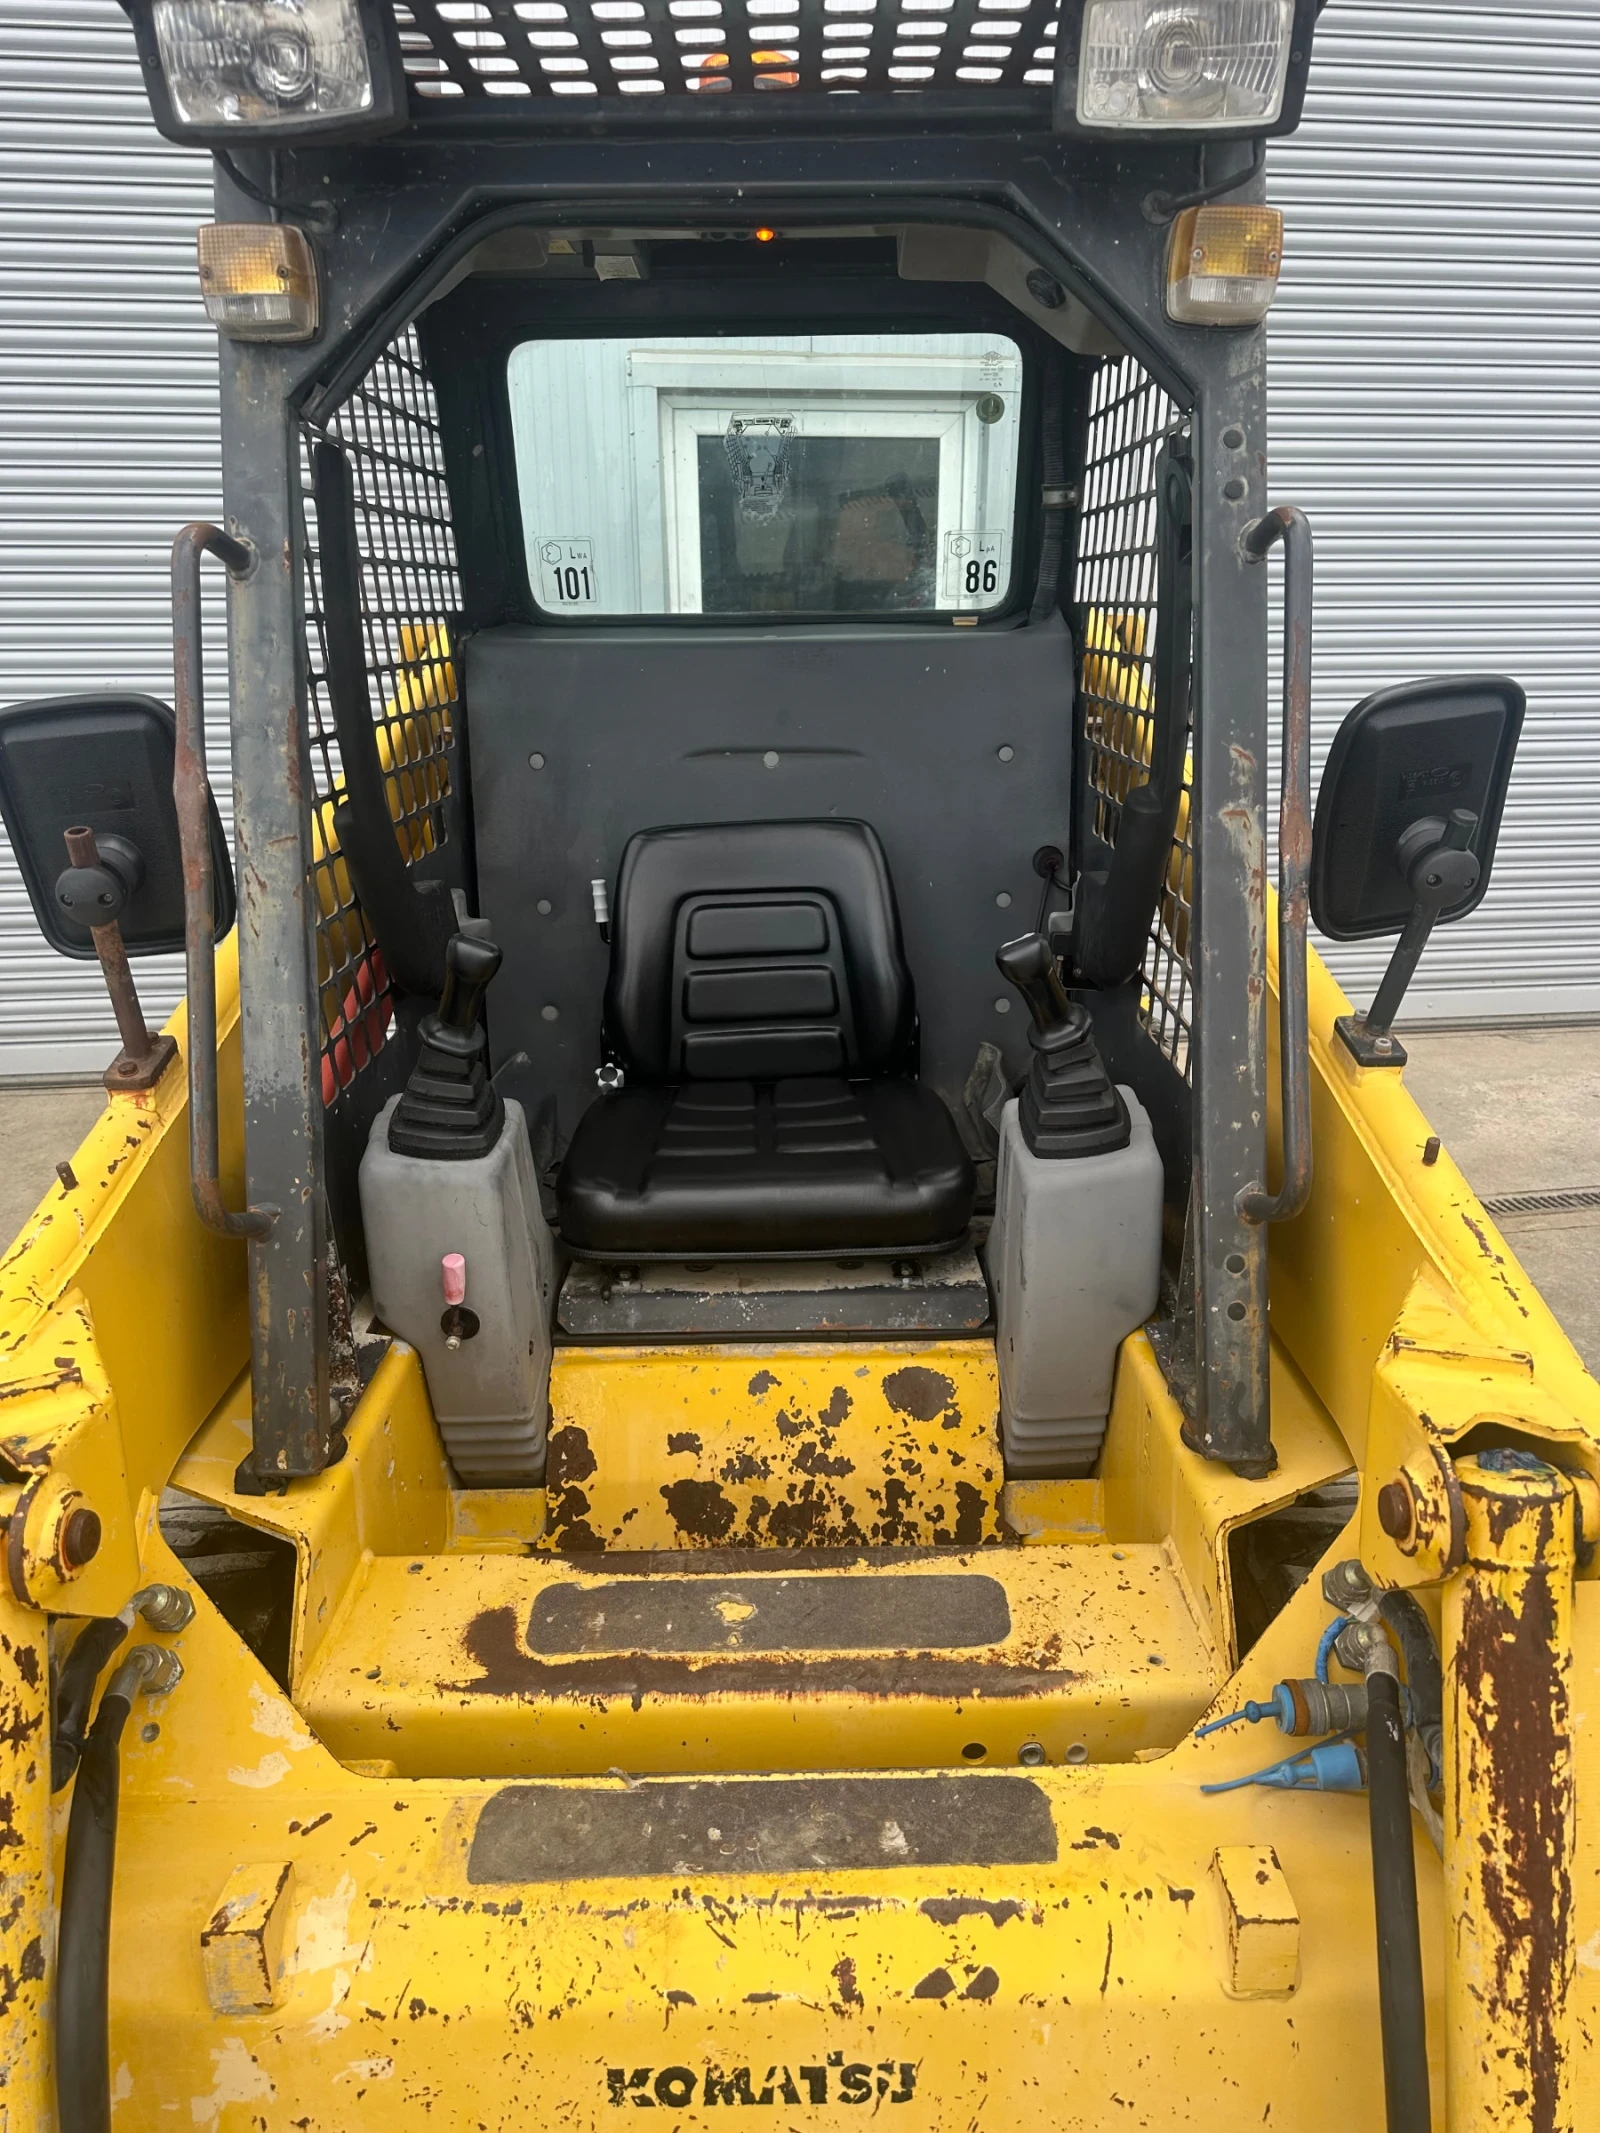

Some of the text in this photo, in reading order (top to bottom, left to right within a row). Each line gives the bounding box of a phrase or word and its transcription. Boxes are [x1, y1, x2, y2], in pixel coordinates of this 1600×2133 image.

[553, 566, 591, 600] 101
[965, 560, 997, 593] 86
[606, 2055, 918, 2108] KOMATSU
